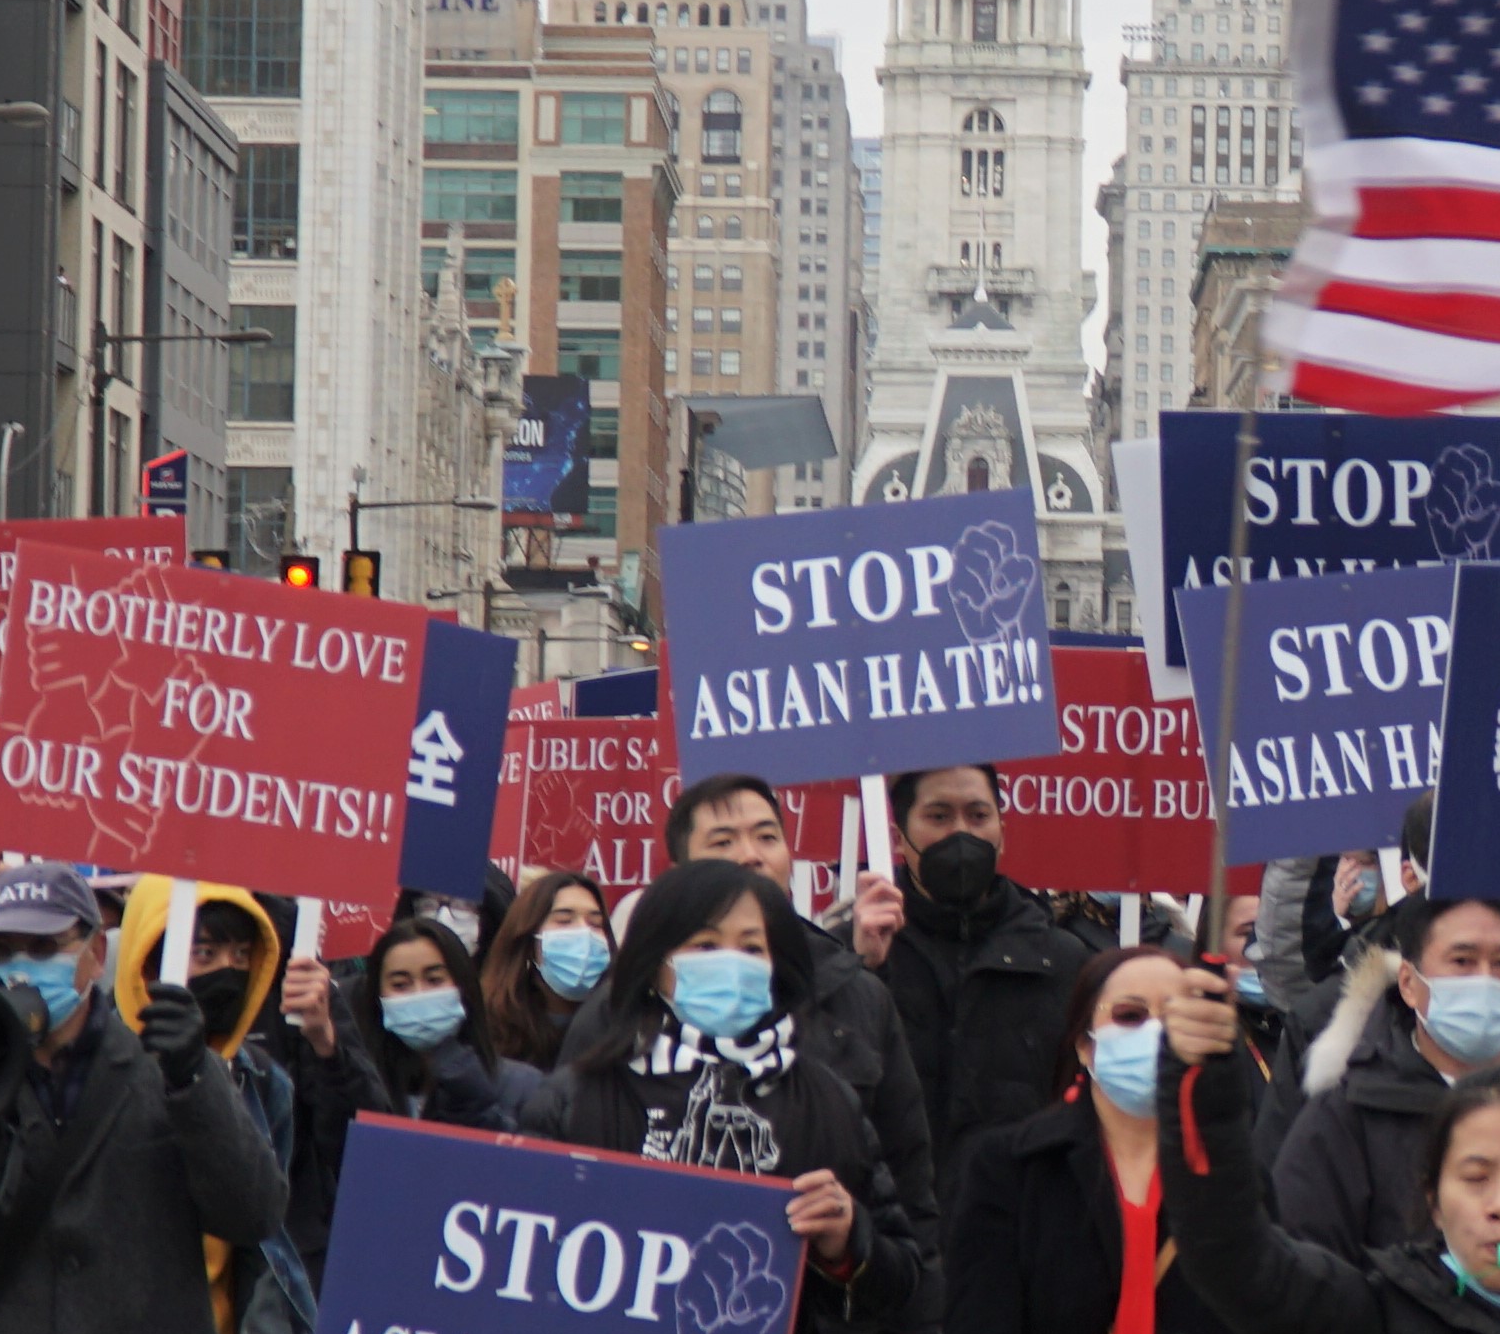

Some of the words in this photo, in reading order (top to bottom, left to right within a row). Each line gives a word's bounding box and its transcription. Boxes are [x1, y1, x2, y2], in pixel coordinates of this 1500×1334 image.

[511, 418, 544, 448] ON
[1242, 456, 1432, 527] STOP
[750, 542, 955, 635] STOP
[26, 579, 286, 663] BROTHERLY
[291, 621, 408, 685] LOVE
[1269, 615, 1450, 703] STOP
[160, 677, 255, 741] FOR
[690, 657, 852, 741] ASIAN
[867, 636, 1044, 720] HATE!!
[1, 734, 102, 799] OUR
[115, 751, 393, 844] STUDENTS!!
[595, 790, 653, 826] FOR
[996, 773, 1144, 818] SCHOOL
[1226, 728, 1373, 809] ASIAN
[433, 1200, 691, 1323] STOP
